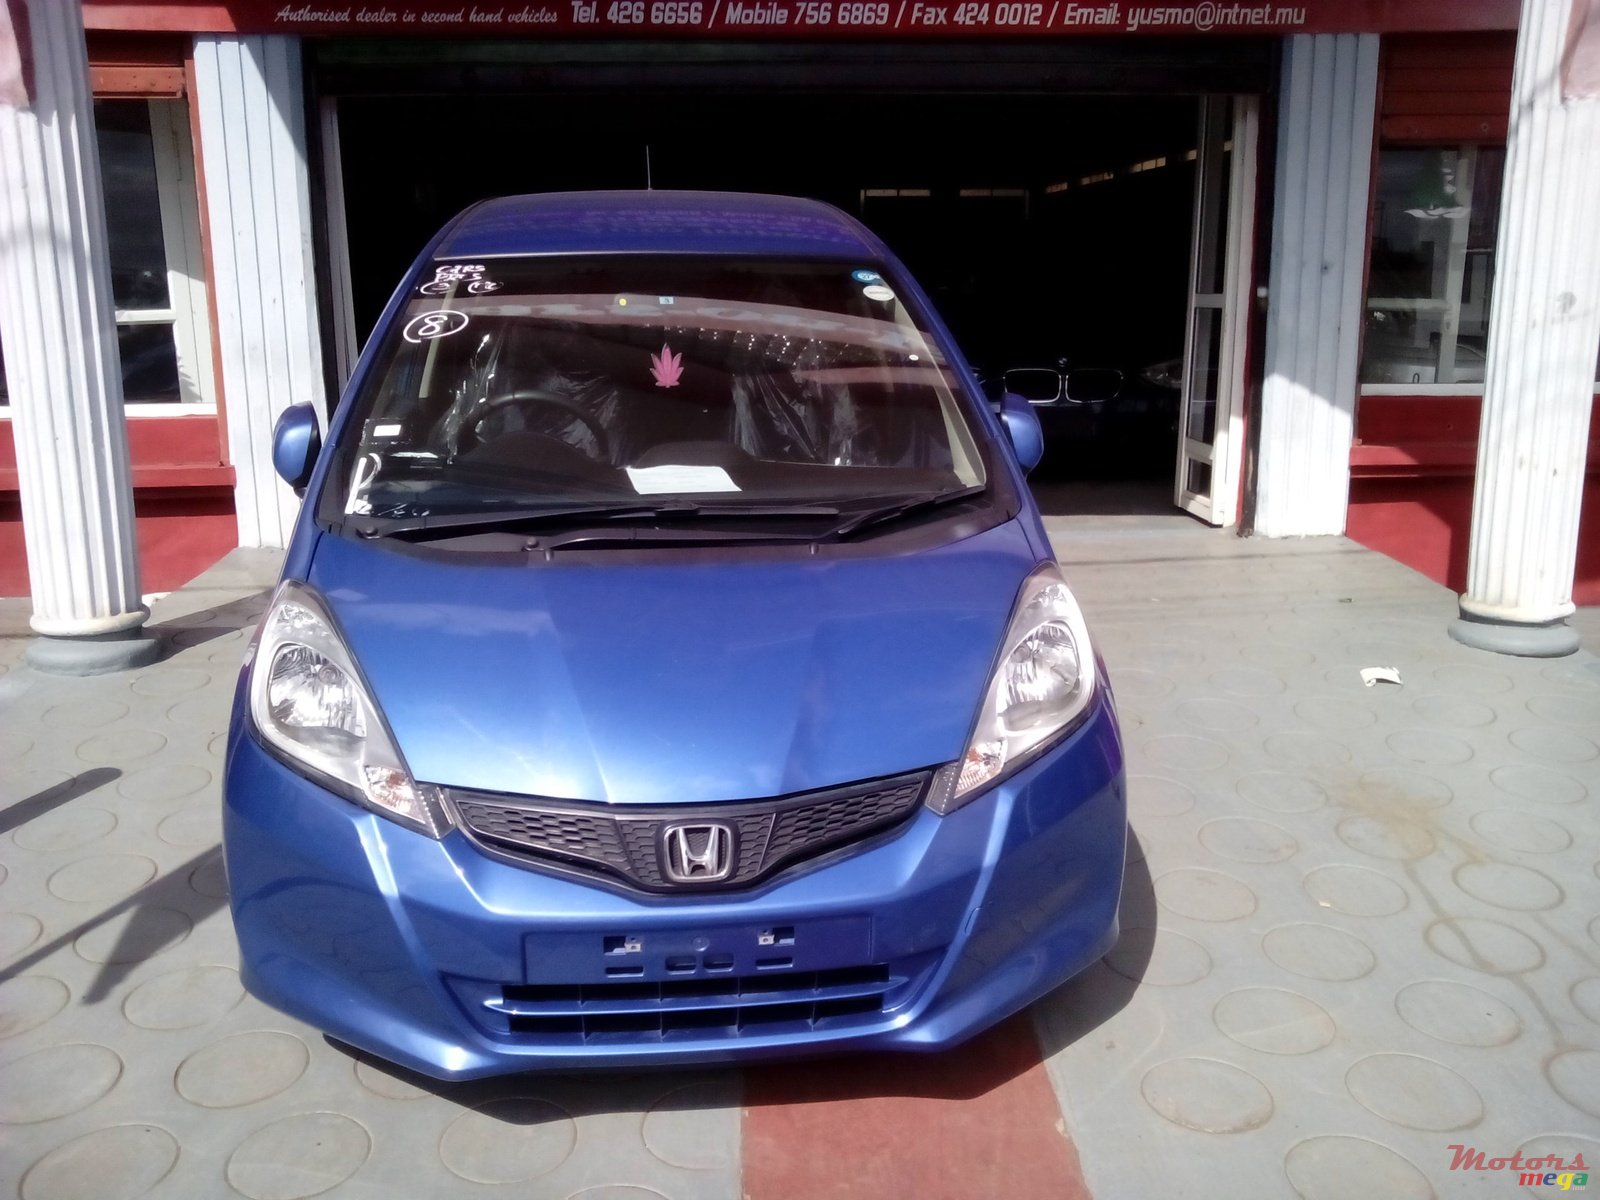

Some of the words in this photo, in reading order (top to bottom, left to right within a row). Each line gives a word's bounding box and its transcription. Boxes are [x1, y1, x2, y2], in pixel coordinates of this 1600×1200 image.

[274, 4, 351, 22] Authorised
[355, 6, 397, 23] dealer
[402, 9, 416, 23] in
[421, 7, 465, 23] second
[469, 6, 504, 23] hand
[507, 5, 558, 23] vehicles
[571, 0, 600, 24] Tel.
[606, 0, 645, 24] 426
[650, 1, 703, 25] 6656
[724, 1, 789, 25] Mobile
[794, 2, 832, 25] 756
[837, 2, 890, 25] 6869
[910, 2, 948, 25] Fax
[952, 2, 990, 25] 424
[994, 3, 1043, 25] 0012
[1063, 2, 1121, 25] Email:
[1125, 1, 1306, 31] yusmo@intnet.mu
